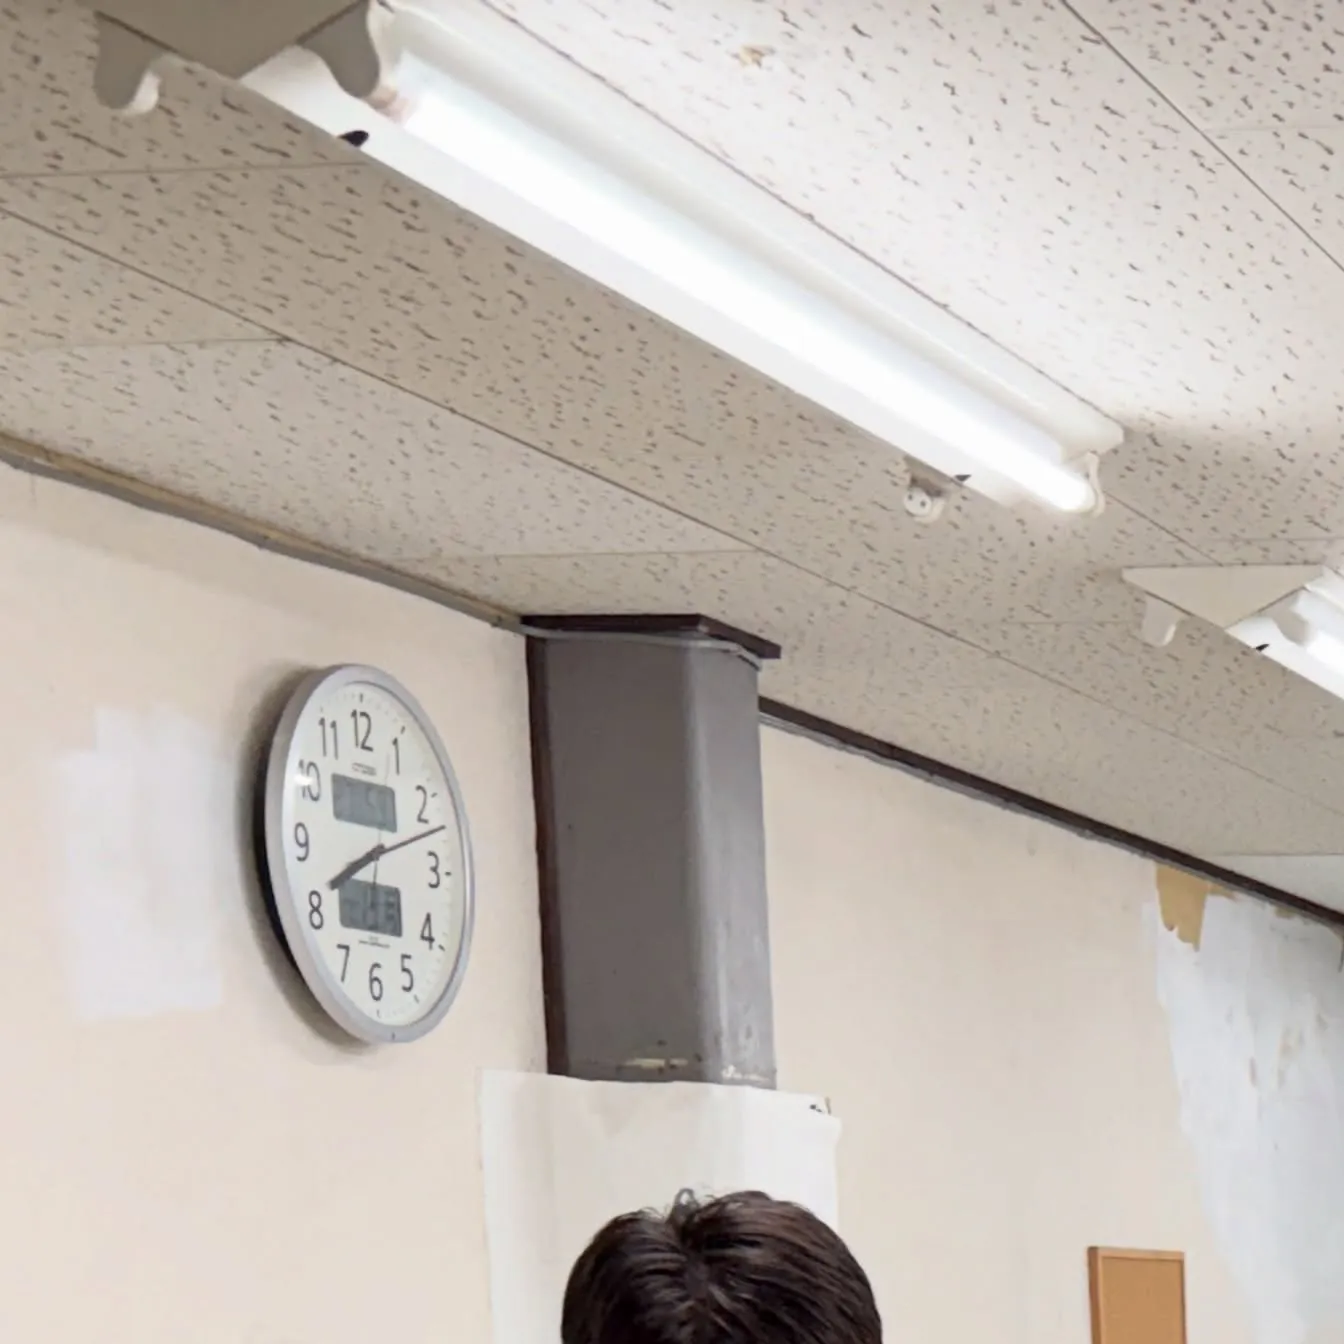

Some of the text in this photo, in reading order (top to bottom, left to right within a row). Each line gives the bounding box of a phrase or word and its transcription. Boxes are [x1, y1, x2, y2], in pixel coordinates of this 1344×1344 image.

[318, 717, 340, 760] 11
[351, 709, 374, 752] 12
[392, 737, 401, 775] 1
[298, 759, 321, 802] 10
[415, 784, 430, 824] 2
[294, 822, 310, 862] 9
[427, 851, 441, 890] 3
[308, 890, 324, 930] 8
[420, 912, 436, 951] 4
[336, 943, 351, 983] 7
[368, 962, 383, 1002] 6
[400, 954, 415, 993] 5
